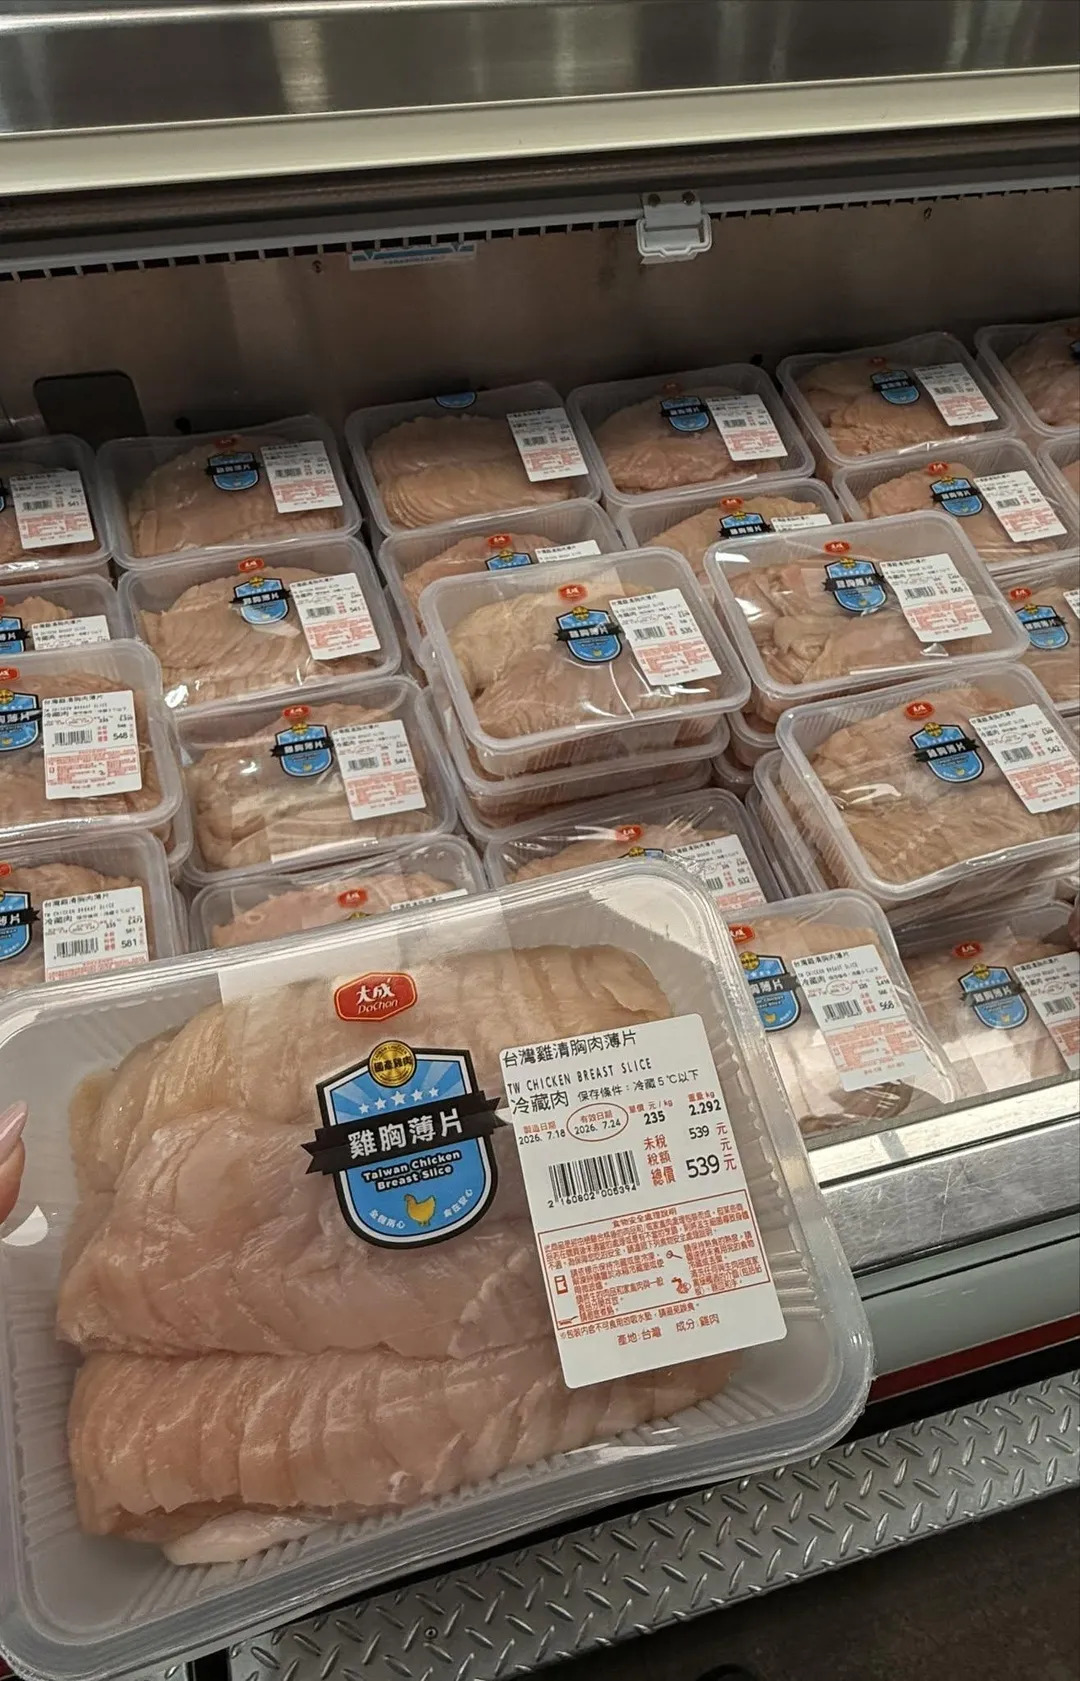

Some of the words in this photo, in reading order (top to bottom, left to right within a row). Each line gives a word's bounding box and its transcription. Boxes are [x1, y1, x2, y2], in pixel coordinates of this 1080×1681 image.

[356, 978, 396, 1005] 大成
[502, 1029, 637, 1068] 台灣雞清胸肉薄片
[507, 1082, 521, 1095] TW
[526, 1072, 572, 1092] CHICKEN
[577, 1065, 614, 1083] BREAST
[621, 1058, 652, 1074] SLICE
[510, 1090, 569, 1115] 冷藏肉
[688, 1099, 722, 1116] 2.292
[602, 1118, 621, 1130] 7.24
[643, 1110, 666, 1125] 235
[347, 1107, 463, 1160] 雞胸薄片
[547, 1128, 566, 1141] 7.18
[644, 1134, 668, 1151] 未稅
[688, 1125, 710, 1140] 539
[716, 1122, 728, 1136] 元
[363, 1163, 408, 1182] Taiwan
[411, 1150, 461, 1170] Chicken
[647, 1150, 672, 1167] 稅額
[720, 1137, 732, 1151] 元
[376, 1172, 419, 1192] Breast
[422, 1165, 452, 1180] Slice
[651, 1165, 677, 1188] 總價
[685, 1154, 720, 1179] 539
[723, 1153, 737, 1171] 元
